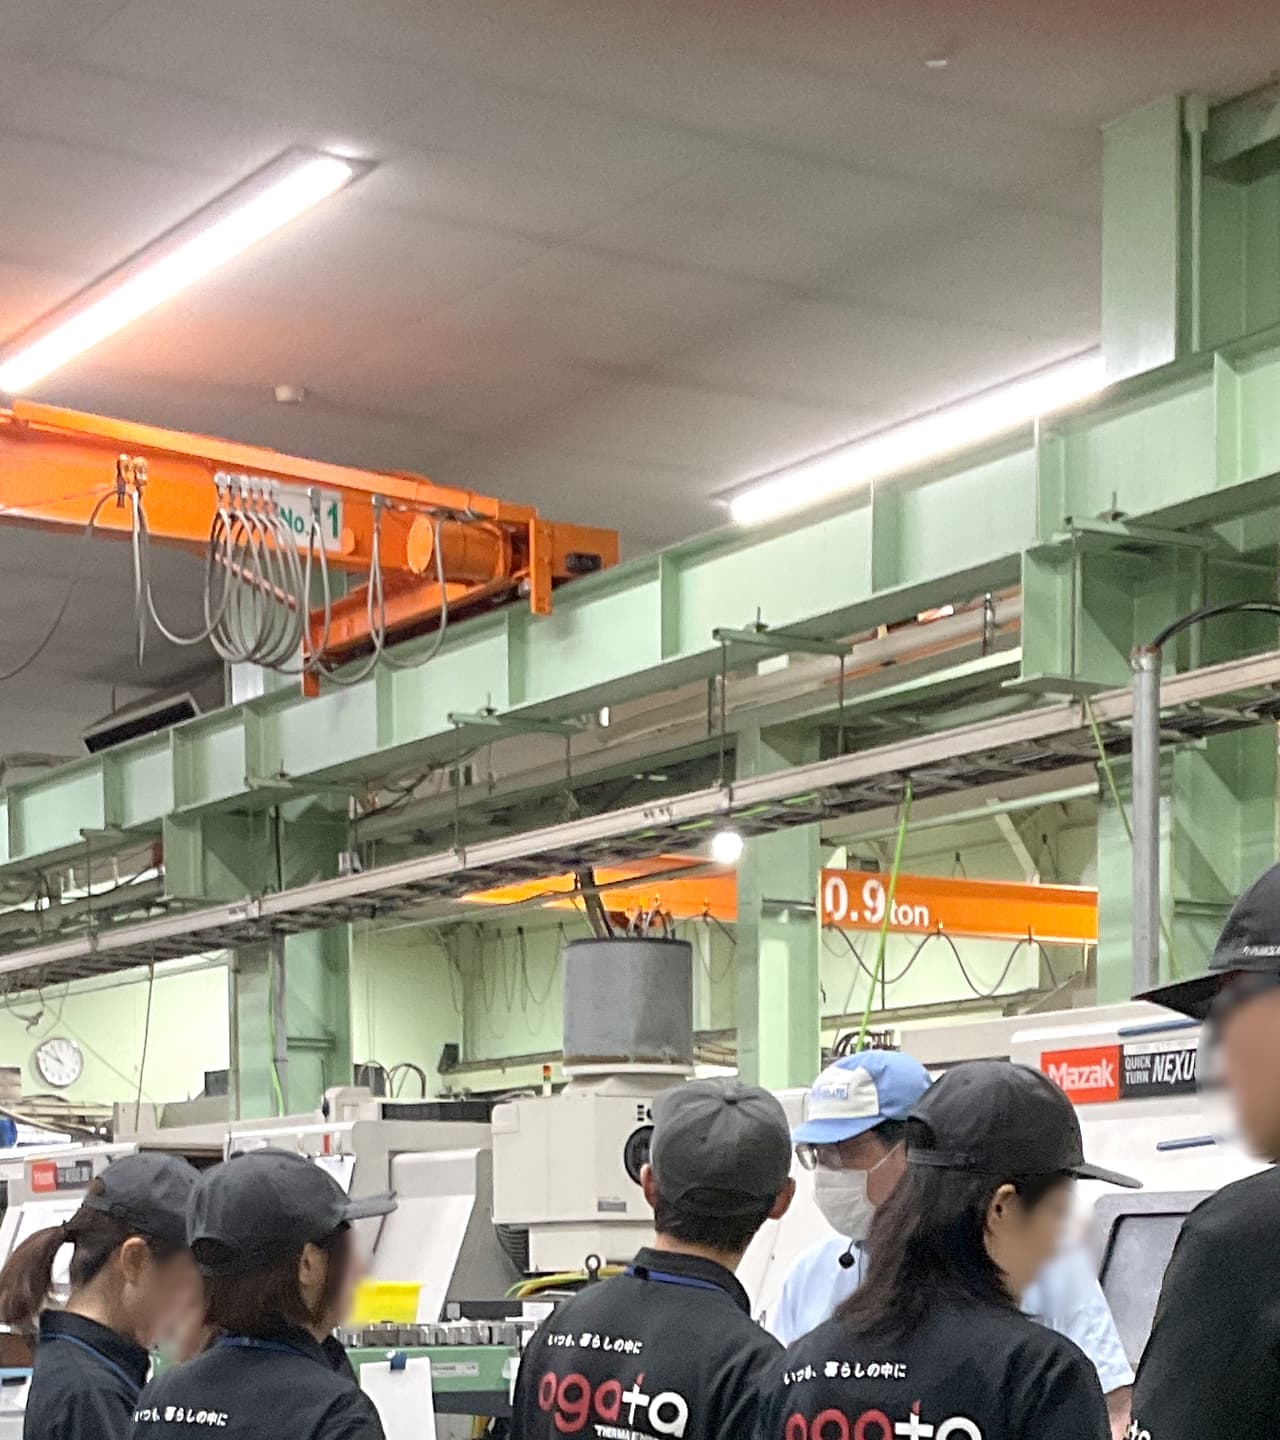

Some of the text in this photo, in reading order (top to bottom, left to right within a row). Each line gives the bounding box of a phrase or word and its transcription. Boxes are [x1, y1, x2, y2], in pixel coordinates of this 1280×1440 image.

[1048, 1058, 1115, 1091] Mazak
[1125, 1050, 1200, 1084] QUICK NEXU
[1125, 1071, 1150, 1085] TURN
[538, 1371, 689, 1433] ogata
